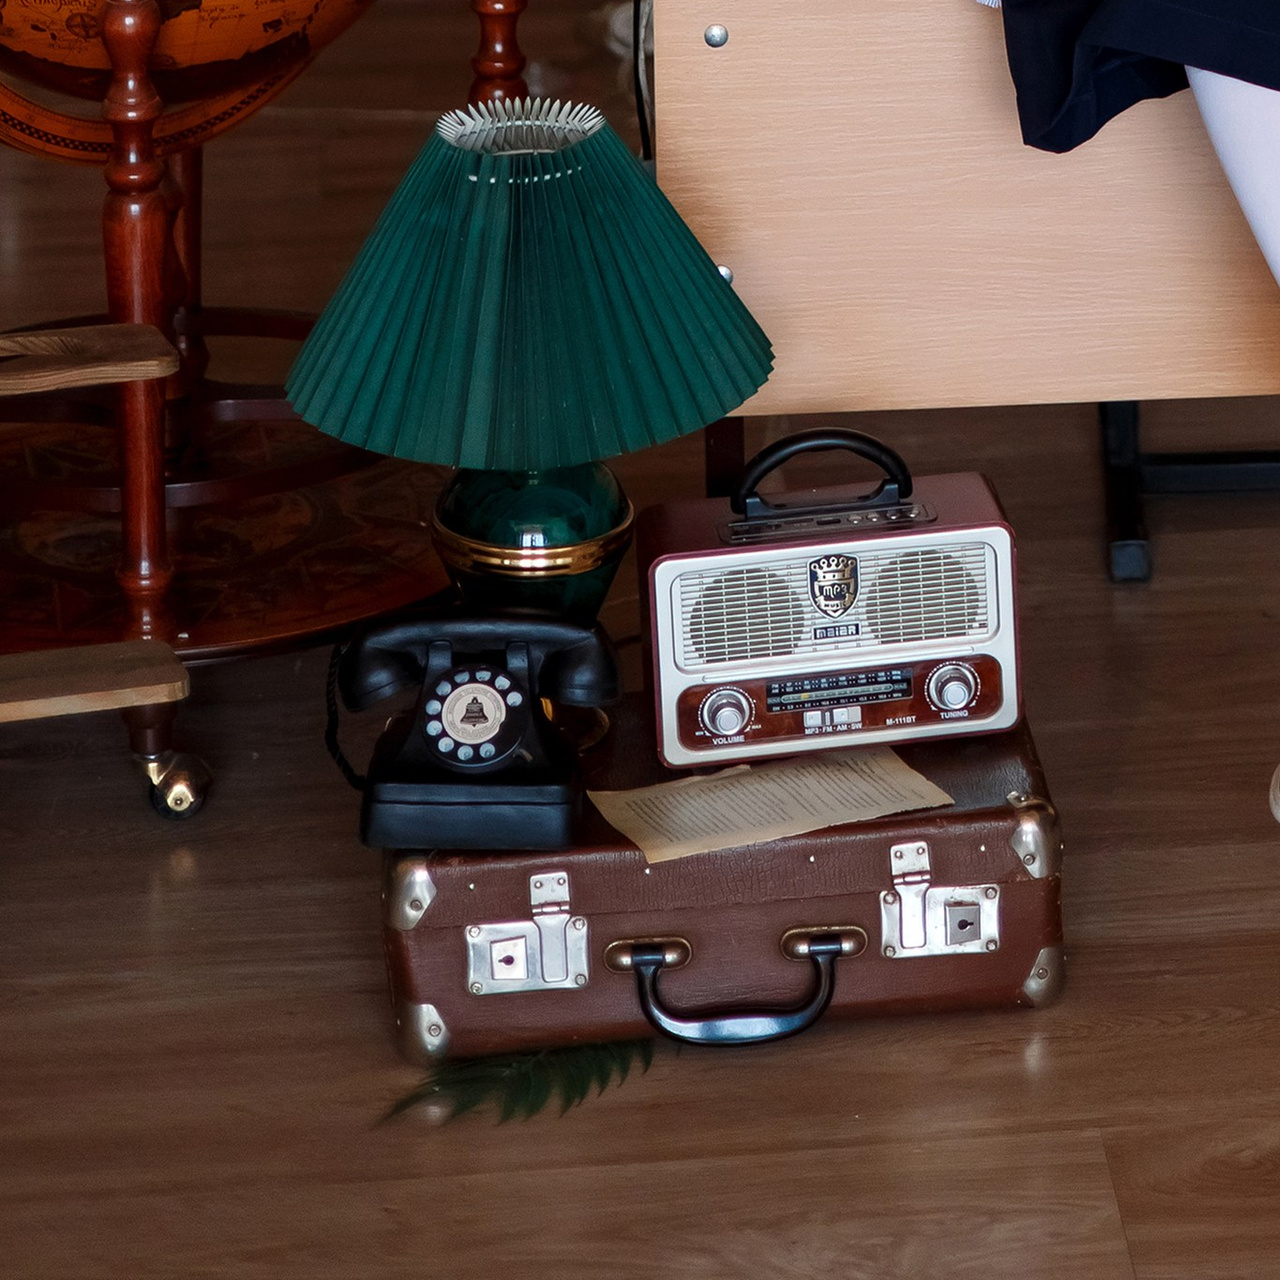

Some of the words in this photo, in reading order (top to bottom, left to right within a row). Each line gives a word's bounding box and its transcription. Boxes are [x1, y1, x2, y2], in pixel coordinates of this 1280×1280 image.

[940, 710, 969, 719] TUNING
[886, 716, 916, 725] M-111BT
[712, 735, 745, 746] VOLUME
